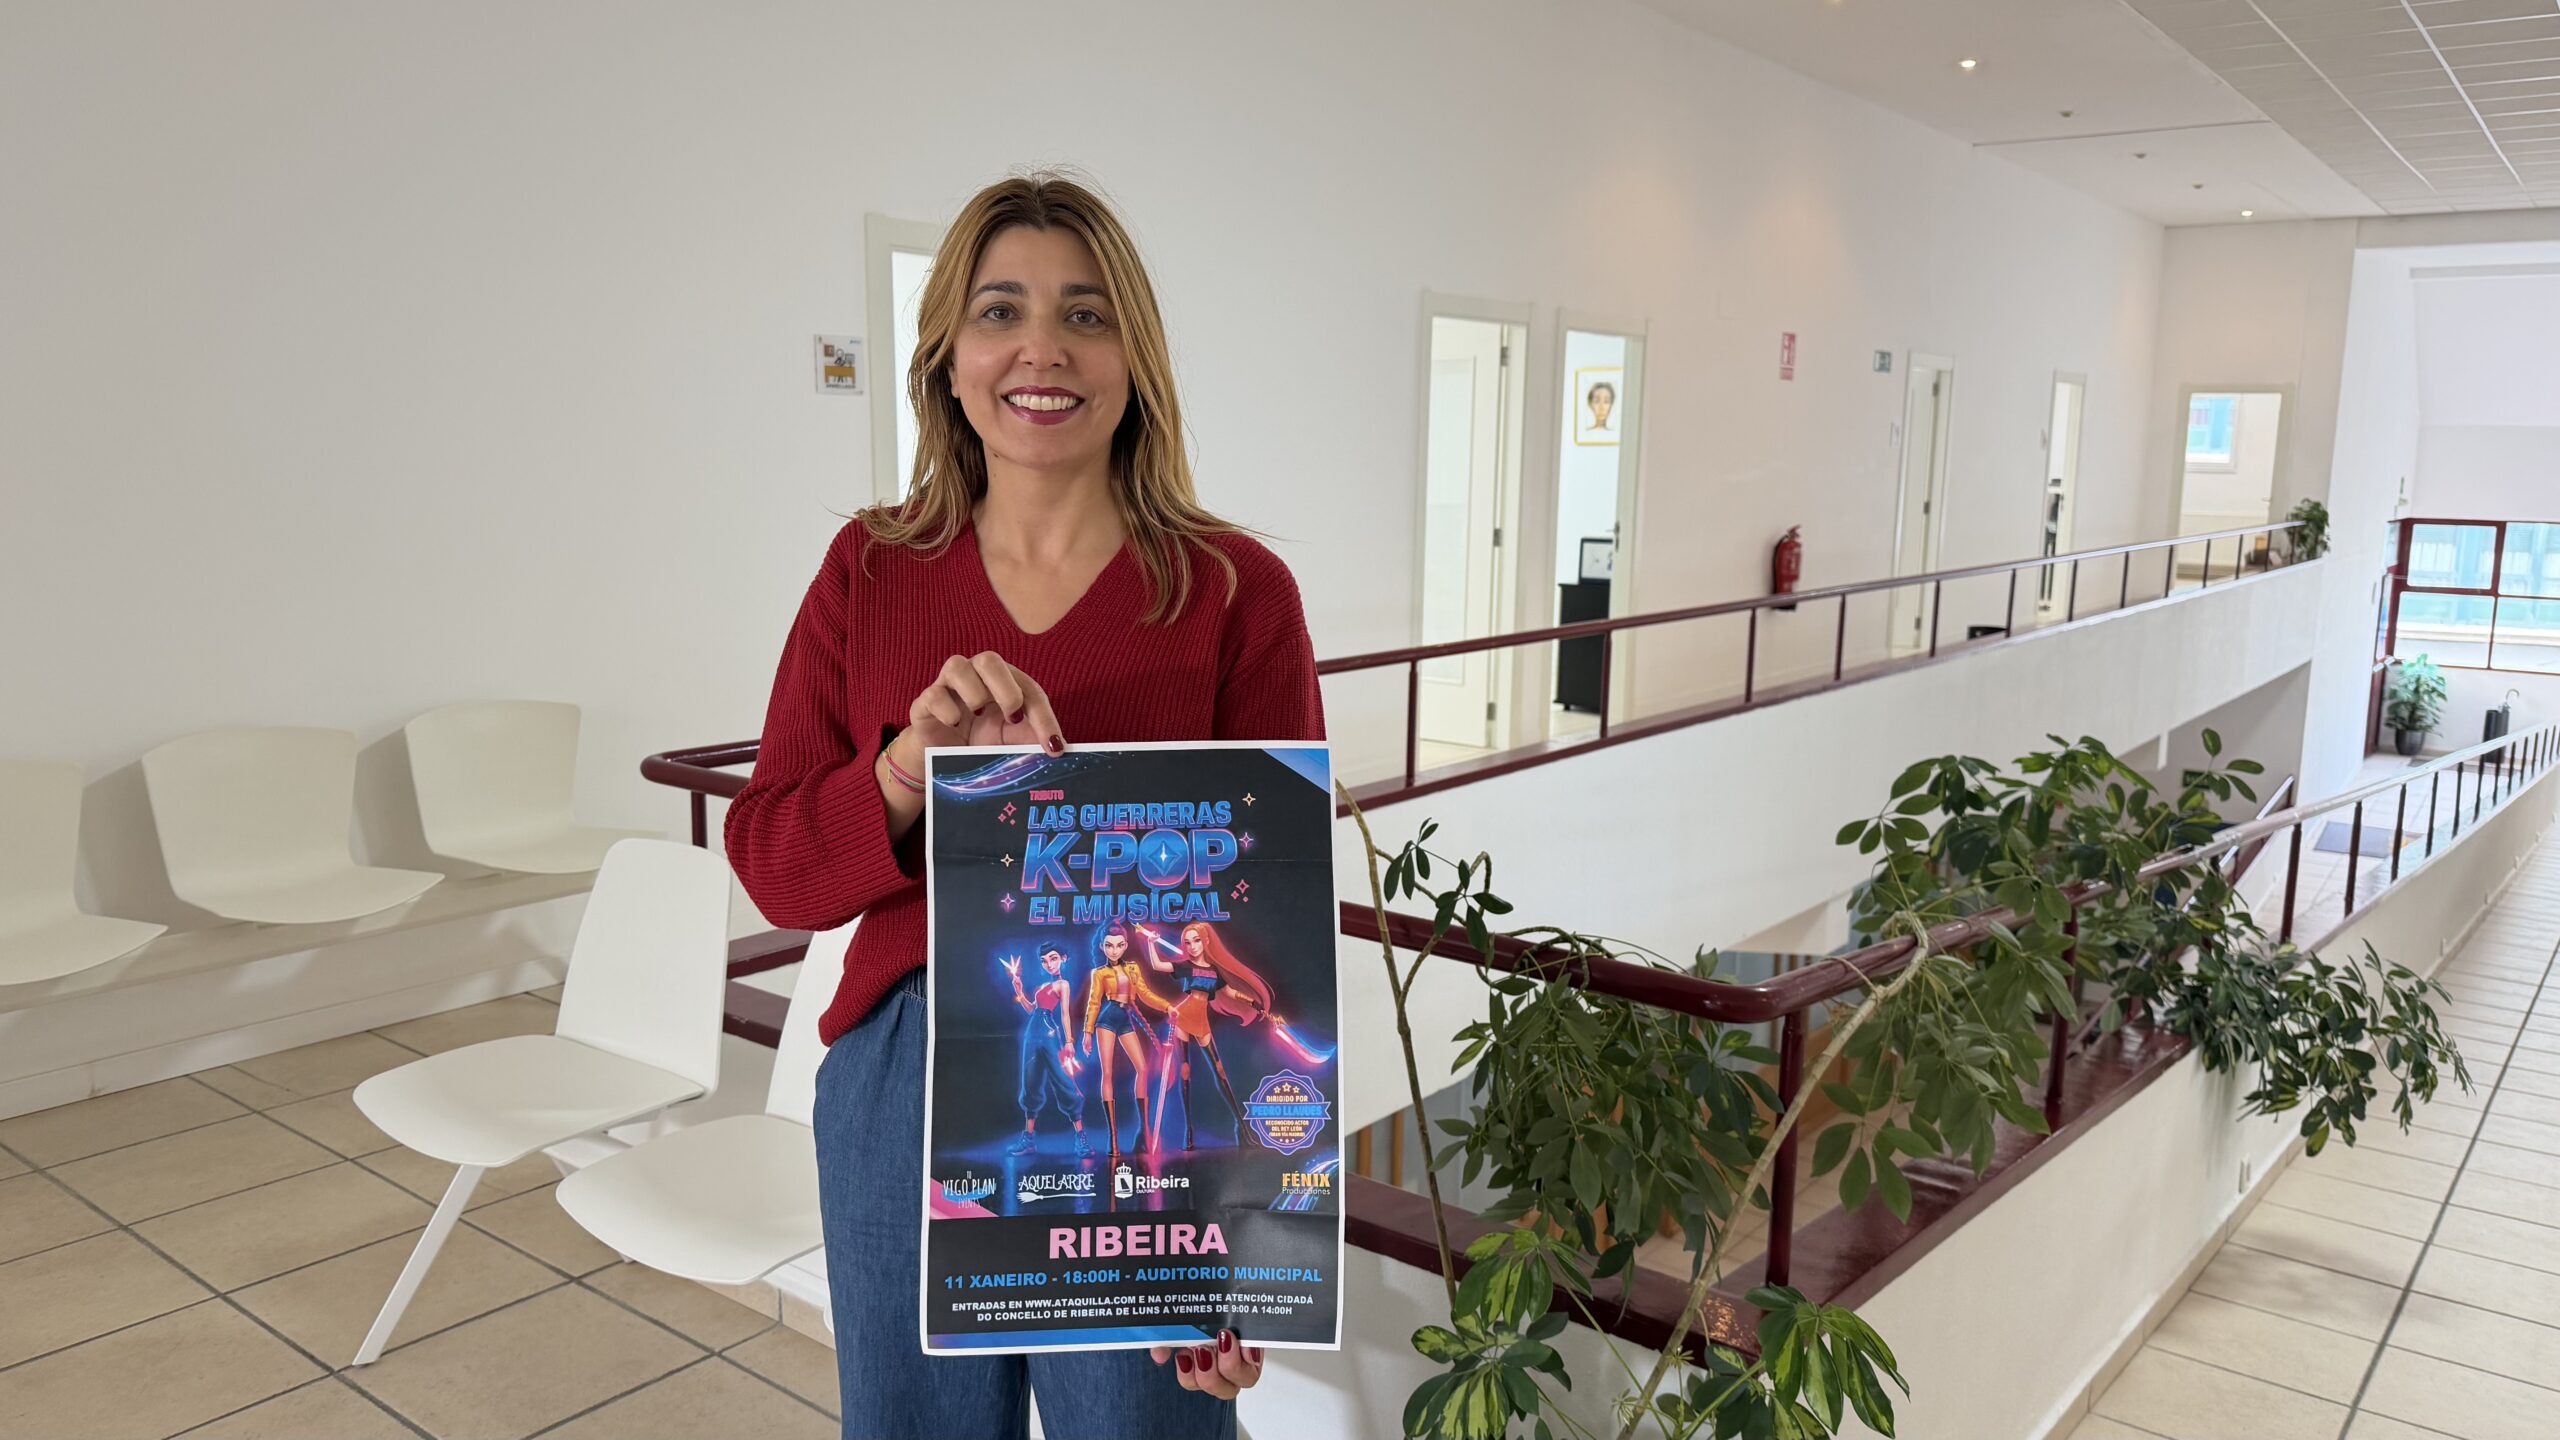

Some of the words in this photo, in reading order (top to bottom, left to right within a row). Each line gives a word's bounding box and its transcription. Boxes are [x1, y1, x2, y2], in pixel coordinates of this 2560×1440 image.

[1029, 790, 1064, 801] TRIBUTO
[1028, 805, 1076, 832] LAS
[1080, 801, 1232, 830] GUERRERAS
[1020, 828, 1238, 892] K-POP
[1029, 896, 1065, 925] EL
[1073, 891, 1231, 923] MUSICAL
[1252, 1105, 1281, 1116] PEDRO
[943, 1179, 968, 1195] VIGO
[972, 1178, 995, 1194] PLAN
[1017, 1174, 1094, 1191] AQUELARRE
[1136, 1175, 1189, 1188] Ribeira
[1282, 1171, 1330, 1187] FÉNIX
[1050, 1223, 1228, 1259] RIBEIRA
[945, 1276, 963, 1288] 11
[969, 1272, 1047, 1288] XANEIRO
[1063, 1269, 1120, 1284] 18:00H
[1135, 1266, 1229, 1281] AUDITORIO
[1234, 1267, 1323, 1282] MUNICIPAL
[952, 1301, 1006, 1311] ENTRADAS
[1009, 1301, 1022, 1309] EN
[1025, 1296, 1136, 1308] WWW.ATAQUILLA.COM
[1148, 1295, 1162, 1303] NA
[1165, 1294, 1206, 1303] OFICINA
[1209, 1293, 1222, 1301] DE
[1225, 1292, 1274, 1303] ATENCIÓN
[1277, 1294, 1313, 1304] CIDADÁ
[977, 1313, 992, 1321] DO
[995, 1311, 1051, 1320] CONCELLO
[1054, 1310, 1068, 1318] DE
[1071, 1308, 1113, 1317] RIBEIRA
[1116, 1307, 1130, 1316] DE
[1132, 1306, 1160, 1314] LUNS
[1163, 1306, 1170, 1314] A
[1173, 1305, 1213, 1313] VENRES
[1231, 1305, 1249, 1313] 9:00
[1261, 1306, 1292, 1315] 14:00H
